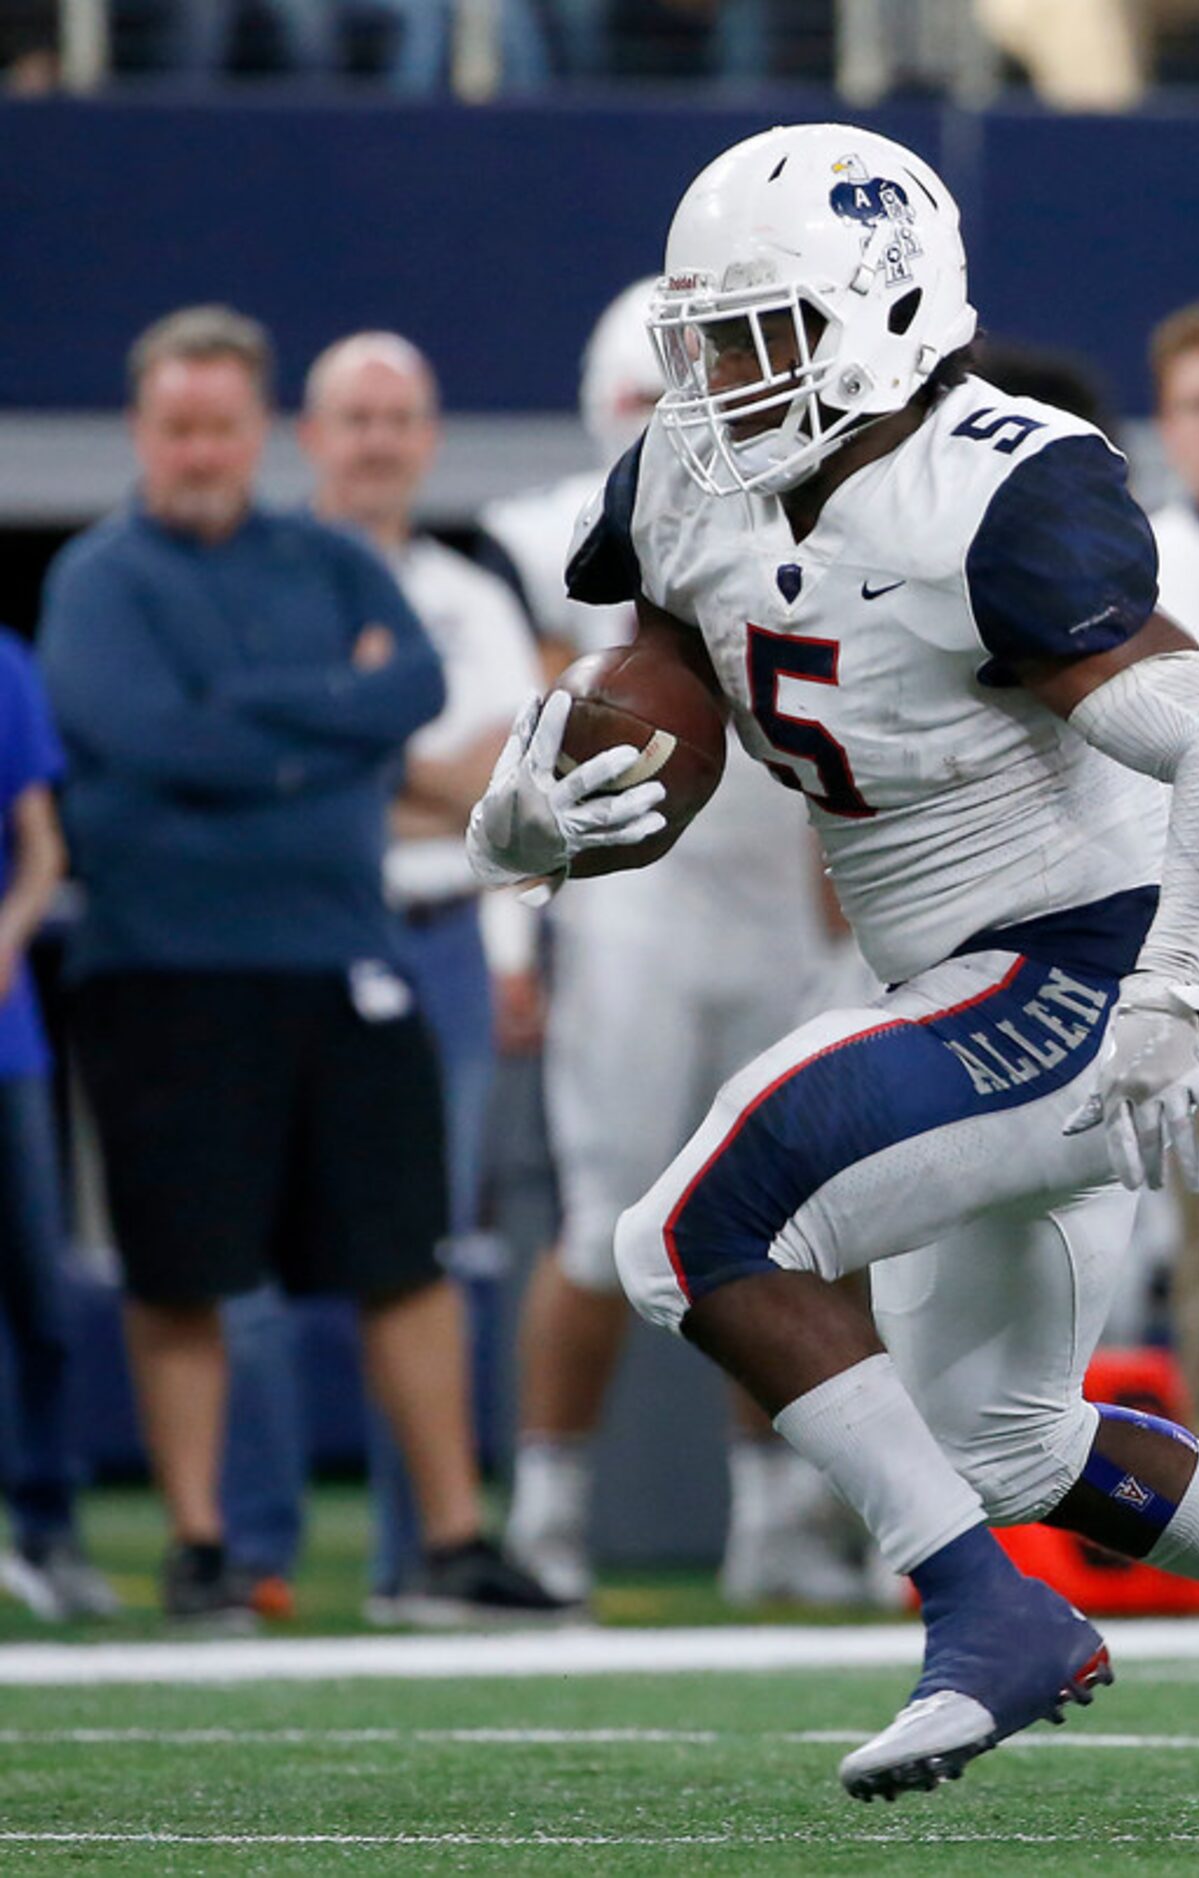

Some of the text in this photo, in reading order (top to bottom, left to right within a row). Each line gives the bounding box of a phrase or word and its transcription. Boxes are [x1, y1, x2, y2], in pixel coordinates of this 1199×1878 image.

[855, 187, 872, 209] A
[951, 406, 1048, 455] 5
[746, 622, 878, 818] 5
[944, 966, 1108, 1095] ALLEN
